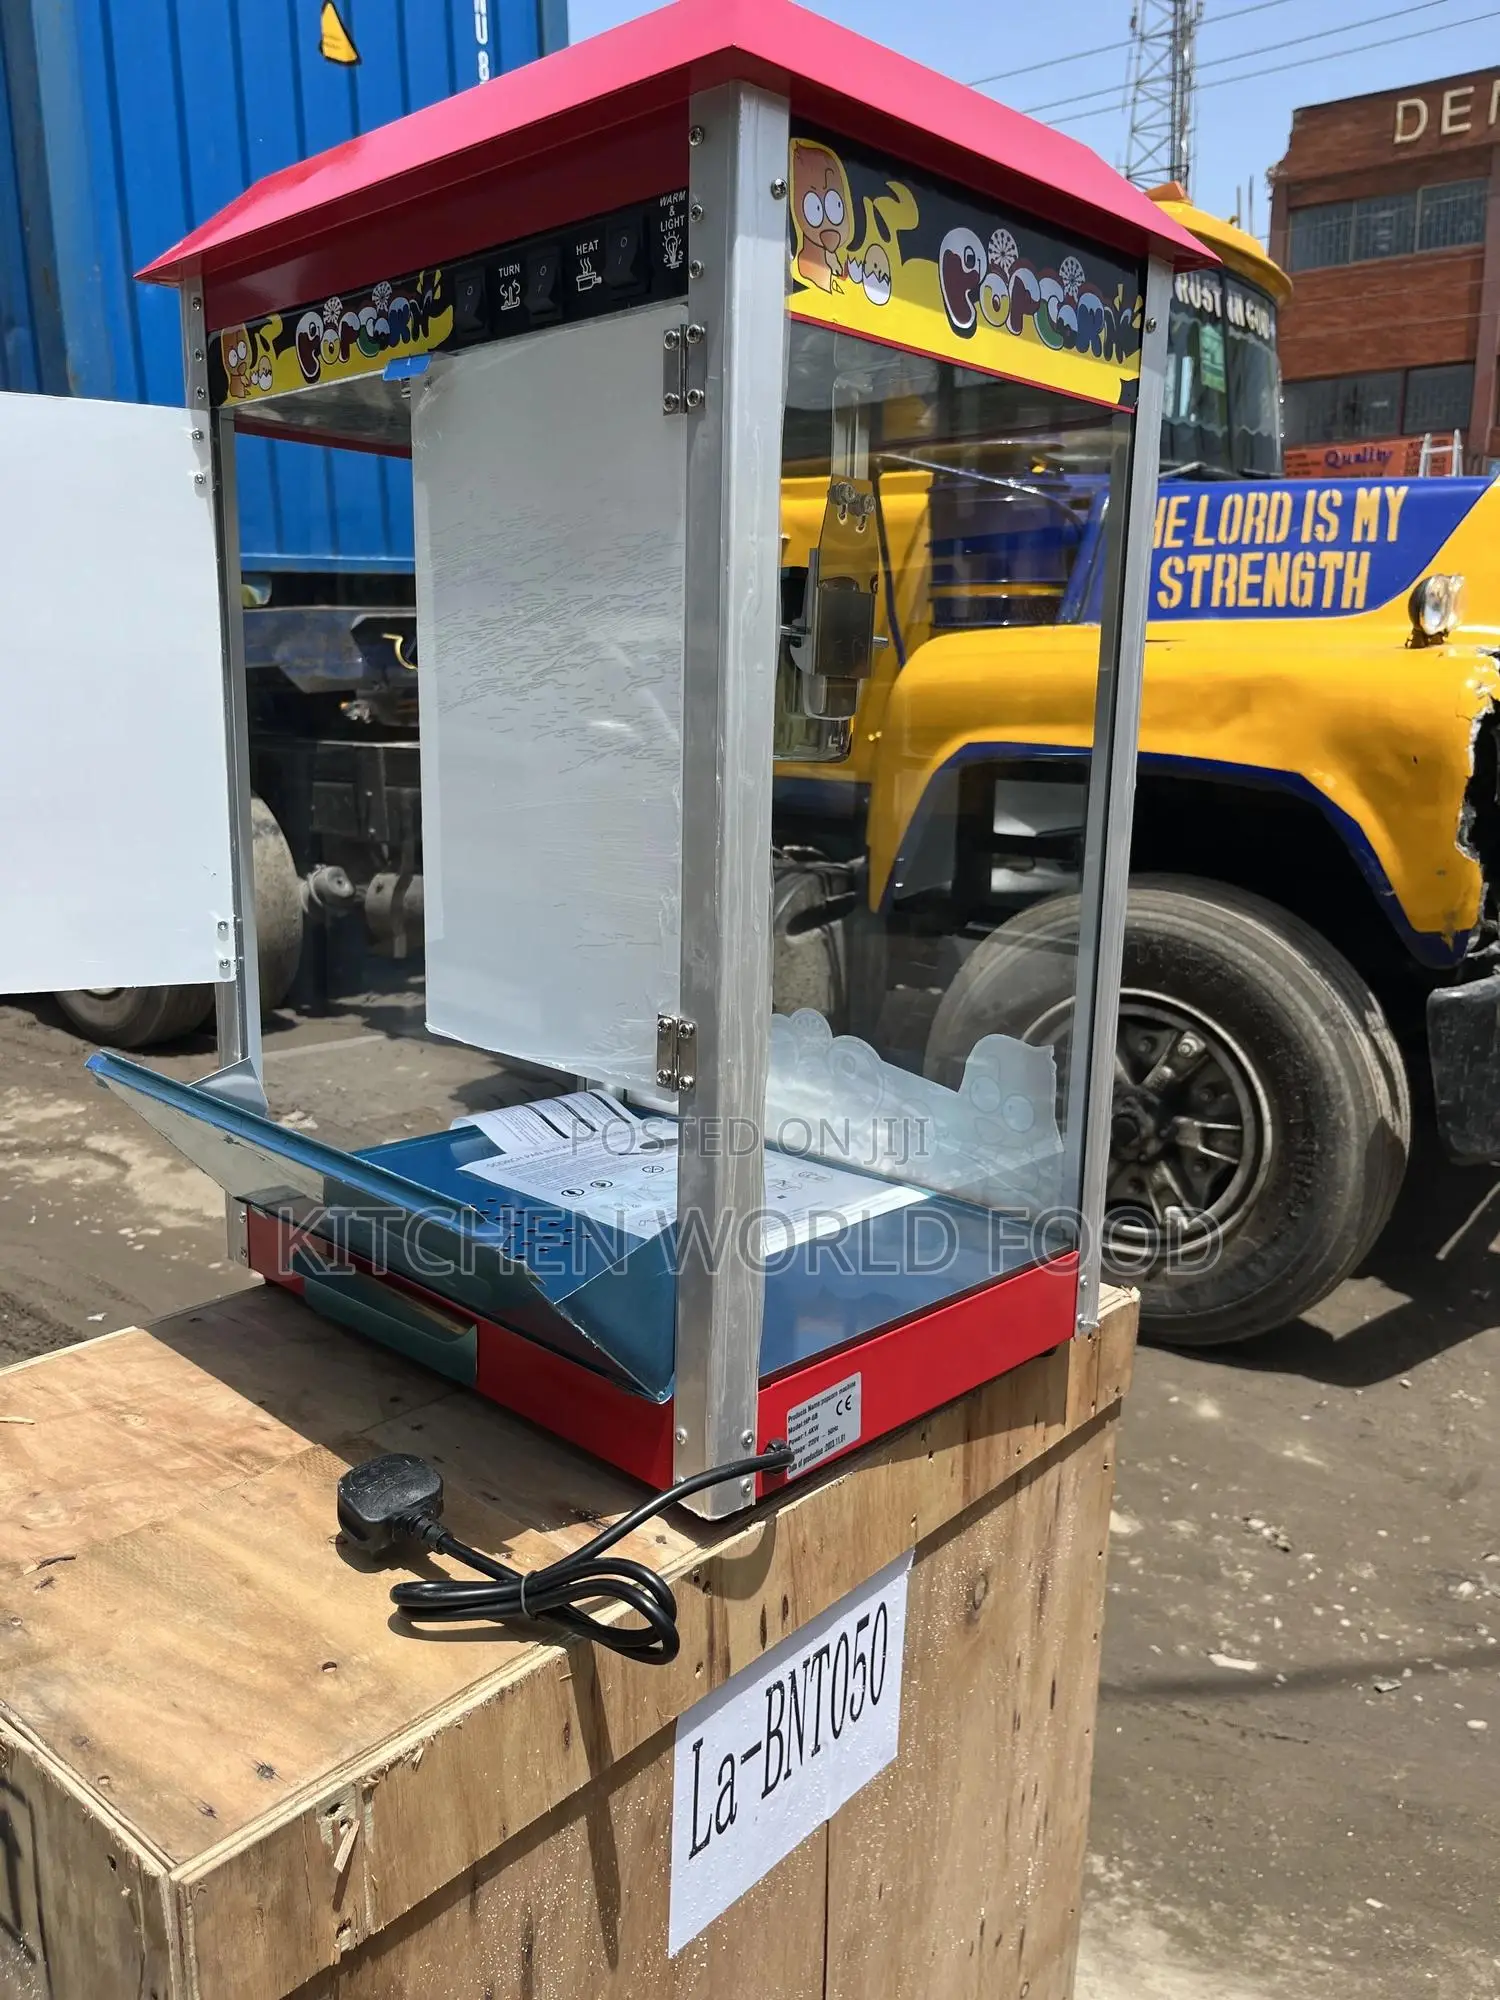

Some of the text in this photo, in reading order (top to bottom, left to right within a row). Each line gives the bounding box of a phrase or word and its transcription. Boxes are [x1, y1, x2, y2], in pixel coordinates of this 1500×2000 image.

[659, 190, 686, 207] WARM
[668, 206, 676, 217] &
[660, 215, 685, 232] LIGHT
[576, 240, 600, 256] HEAT
[498, 263, 521, 278] TURN
[1324, 446, 1394, 469] Quality
[1193, 491, 1294, 546] LORD
[1301, 489, 1342, 544] IS
[1351, 486, 1409, 543] MY
[1157, 551, 1371, 609] STRENGTH
[836, 1395, 852, 1416] CE
[688, 1601, 888, 1860] La-BNT050
